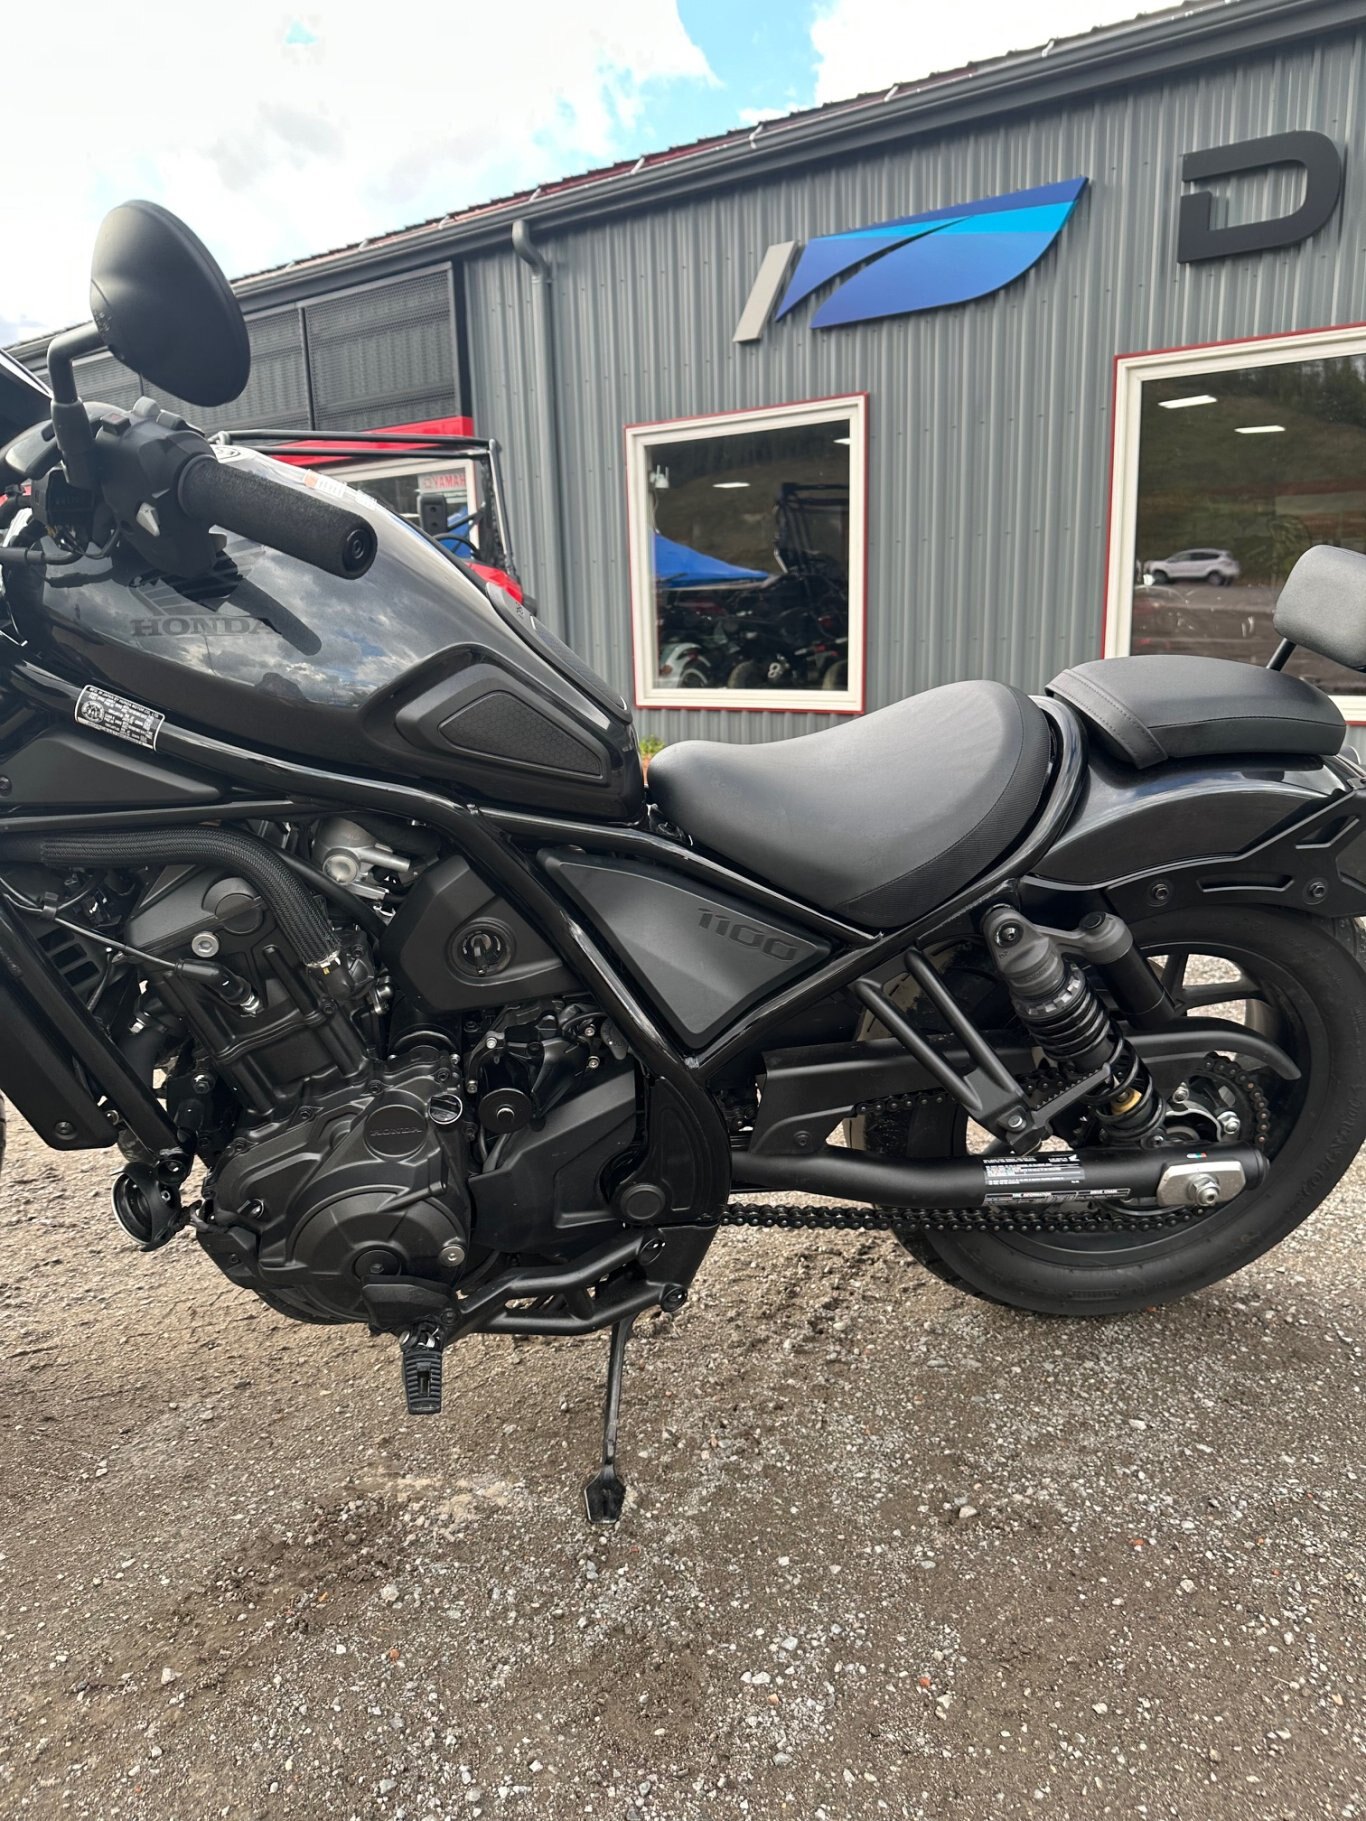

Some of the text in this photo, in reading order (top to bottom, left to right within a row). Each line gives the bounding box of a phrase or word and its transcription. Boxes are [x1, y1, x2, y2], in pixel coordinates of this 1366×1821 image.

[1177, 129, 1342, 264] D
[130, 616, 275, 636] HONDA
[698, 908, 798, 961] 1100
[370, 1127, 423, 1136] HONDA
